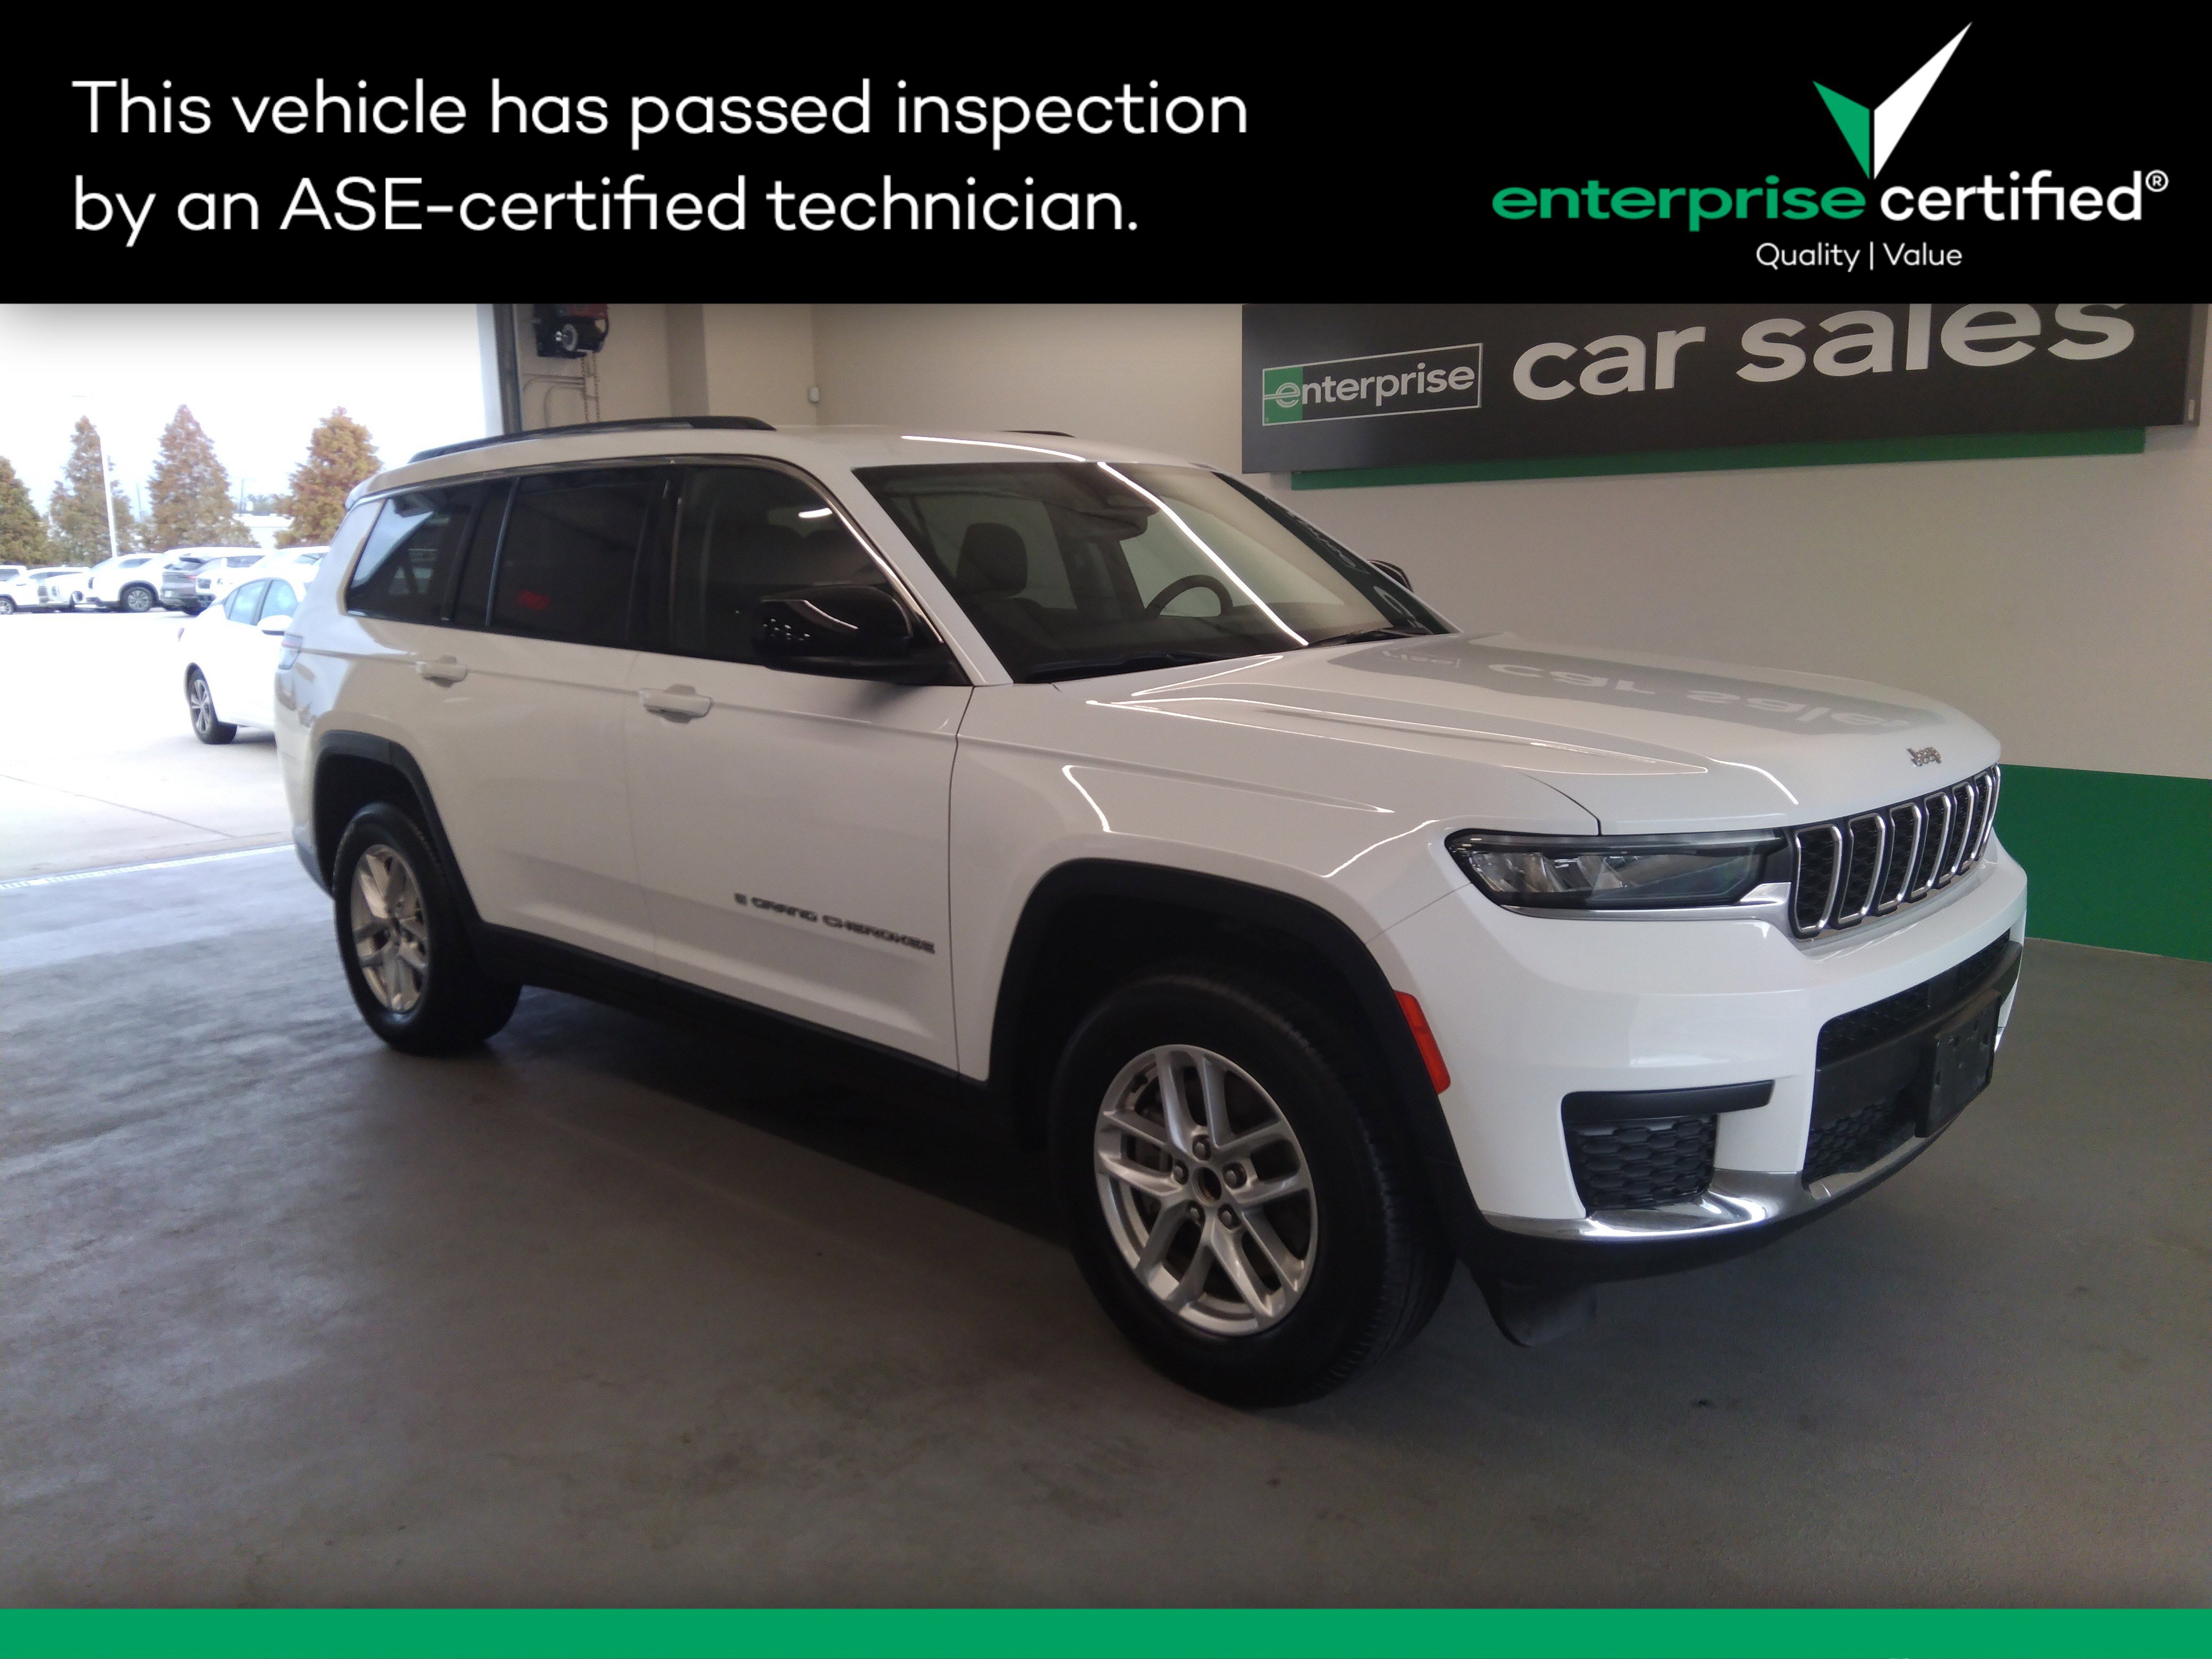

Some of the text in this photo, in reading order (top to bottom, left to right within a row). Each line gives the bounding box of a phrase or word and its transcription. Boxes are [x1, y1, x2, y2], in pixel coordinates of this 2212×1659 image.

[1276, 304, 2134, 408] enterprise car sales
